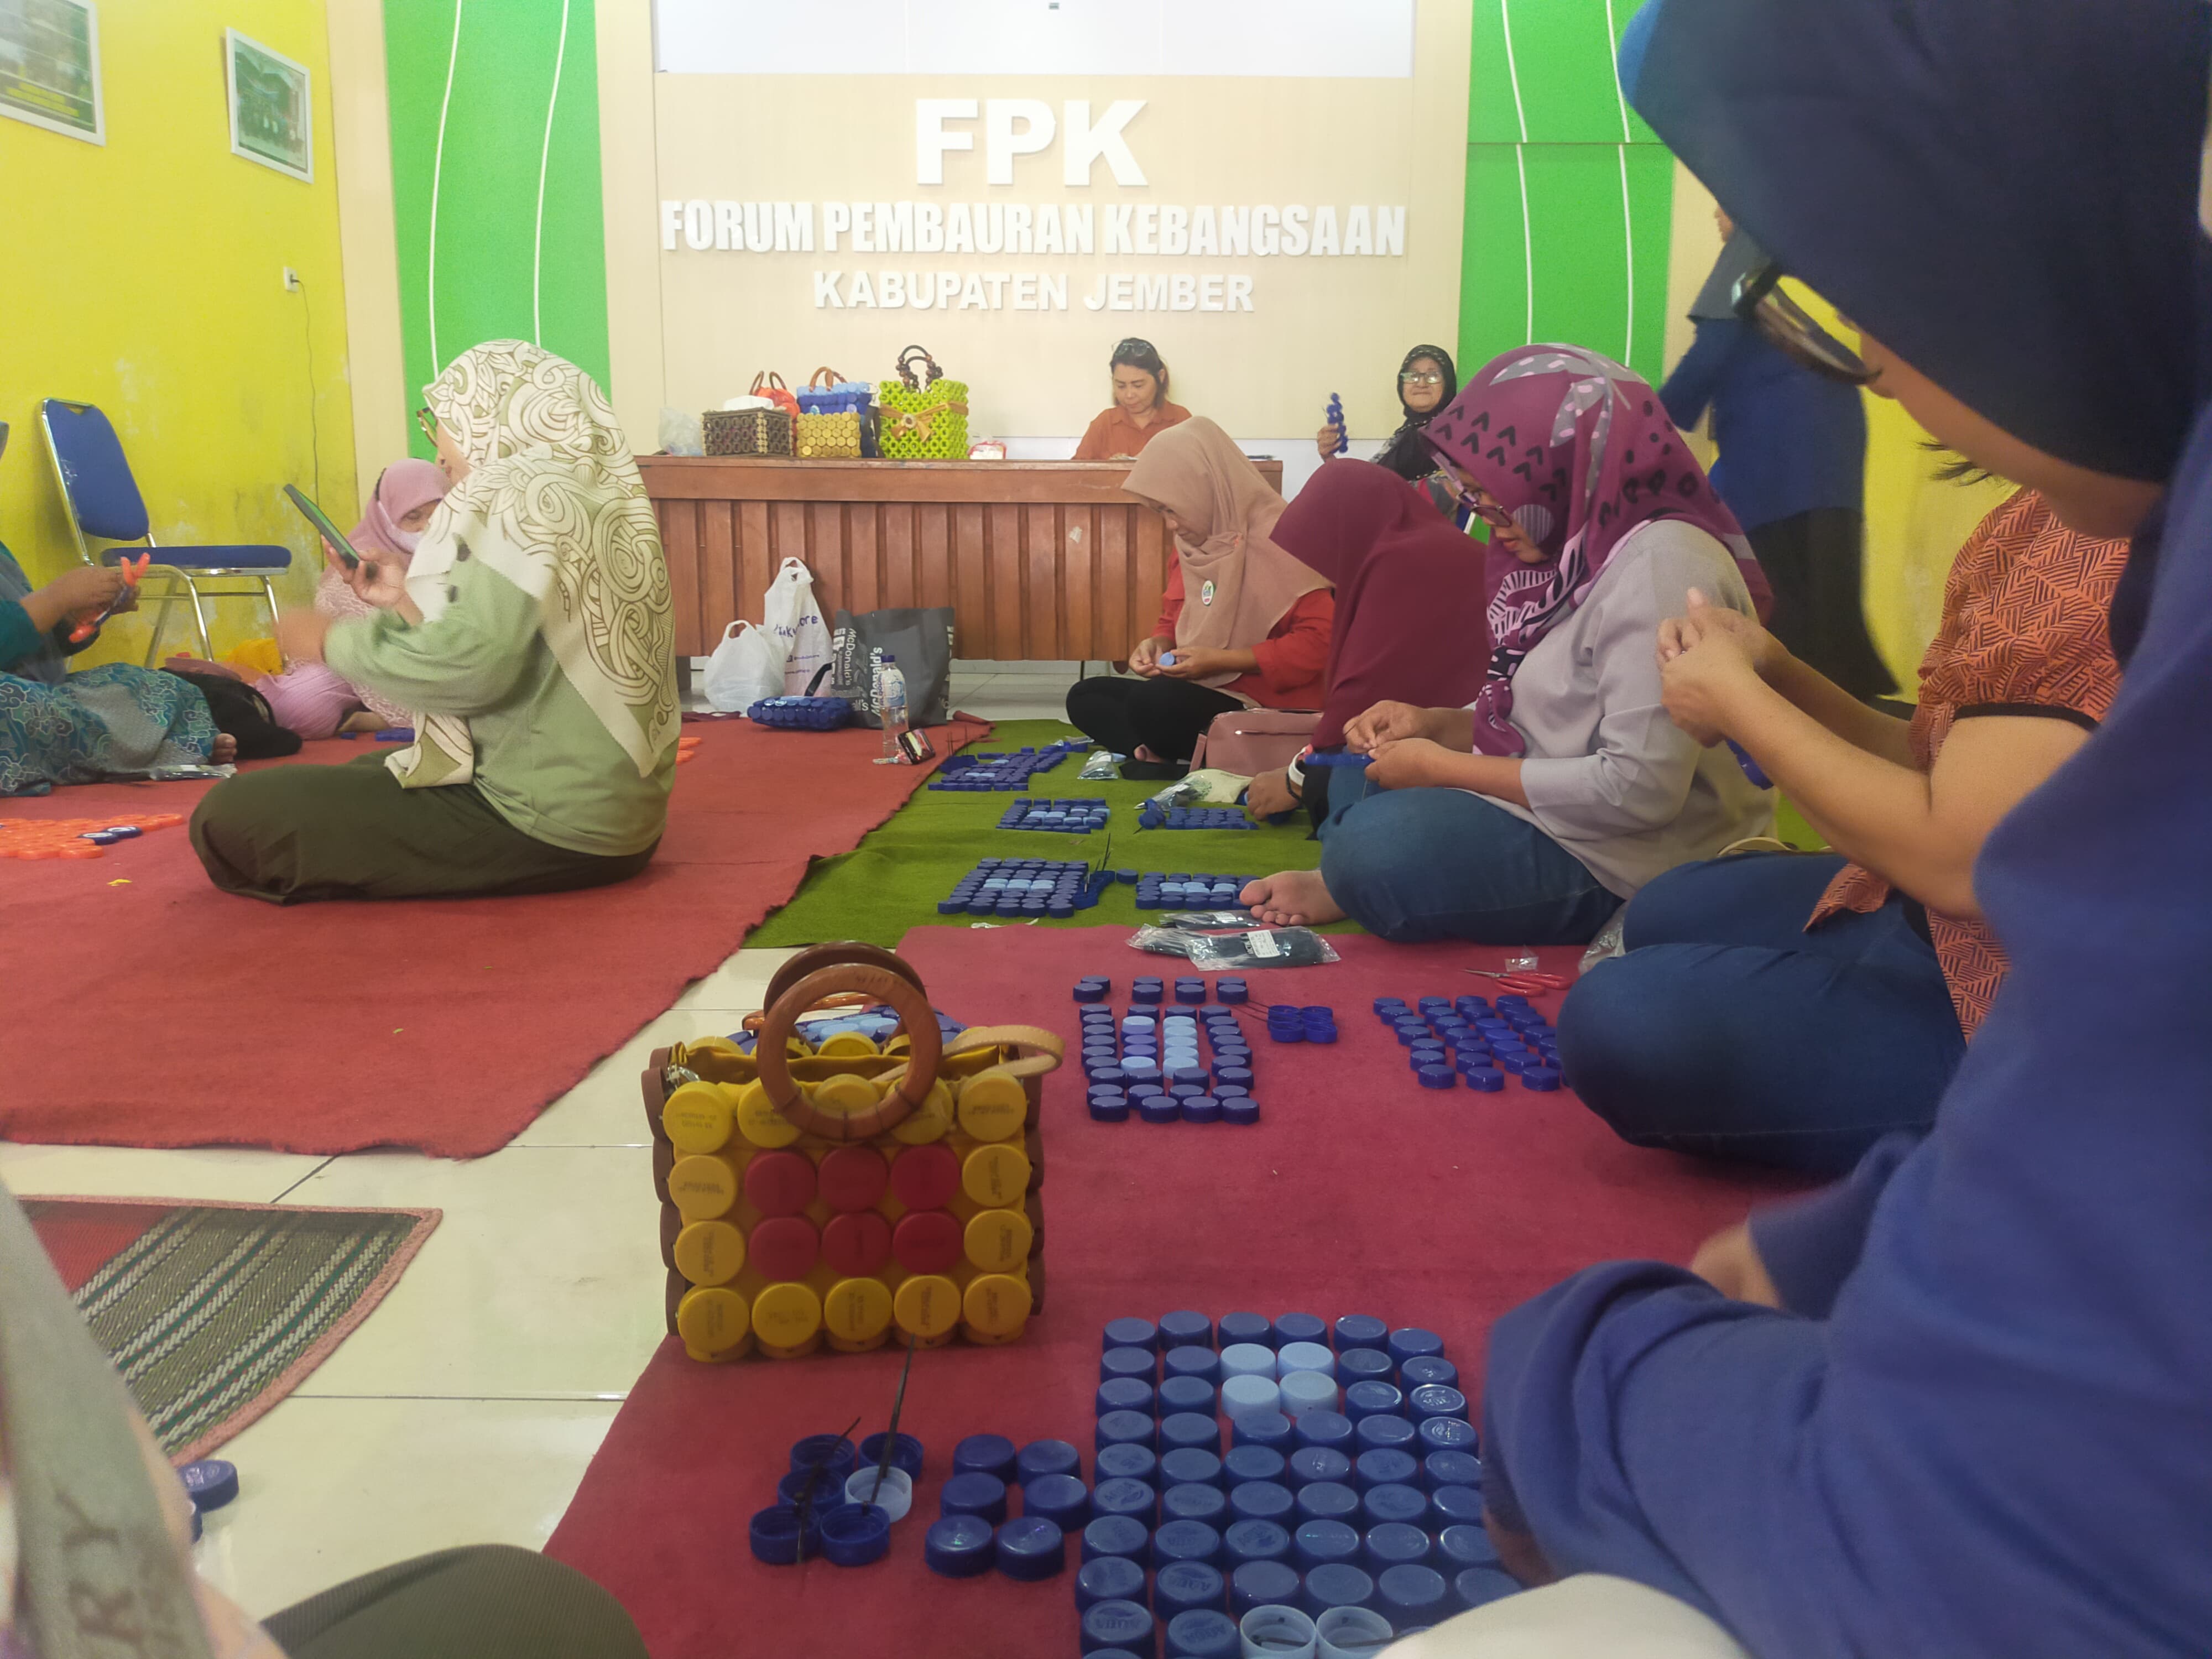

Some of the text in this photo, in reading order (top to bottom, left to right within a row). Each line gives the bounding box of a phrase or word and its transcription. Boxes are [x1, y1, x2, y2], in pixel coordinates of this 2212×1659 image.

[916, 98, 1149, 187] FPK
[663, 199, 1406, 257] FORUM PEMBAURAN KEBANGSAAN
[813, 270, 1255, 312] KABUPATEN JEMBER
[844, 628, 858, 686] McDonald's
